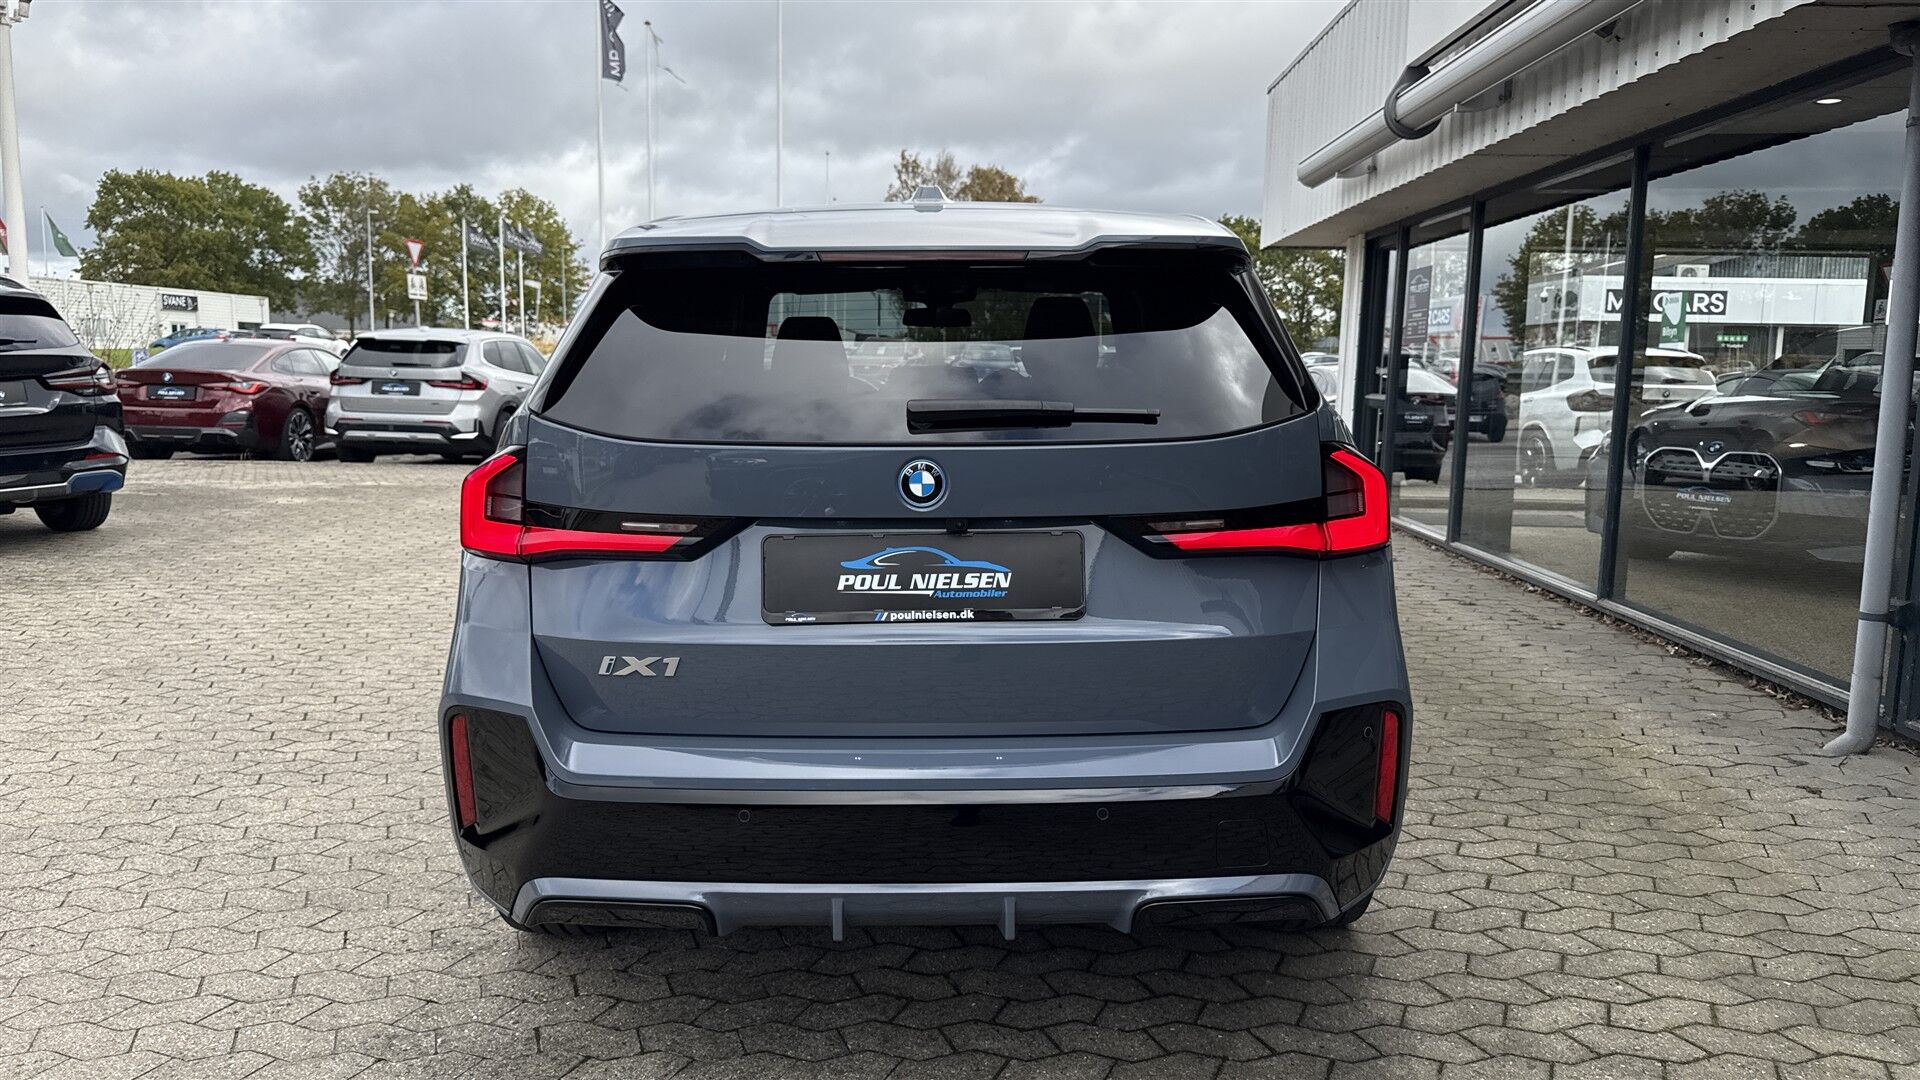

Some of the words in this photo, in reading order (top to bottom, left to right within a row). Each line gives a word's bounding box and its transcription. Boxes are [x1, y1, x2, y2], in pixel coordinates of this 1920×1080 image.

[163, 294, 186, 307] SVANE
[905, 463, 939, 477] BMW
[837, 574, 902, 591] POUL
[910, 572, 1012, 589] NIELSEN
[934, 589, 1008, 598] Automobiler
[890, 609, 975, 621] poulnielsen.dk
[598, 655, 680, 677] iX1
